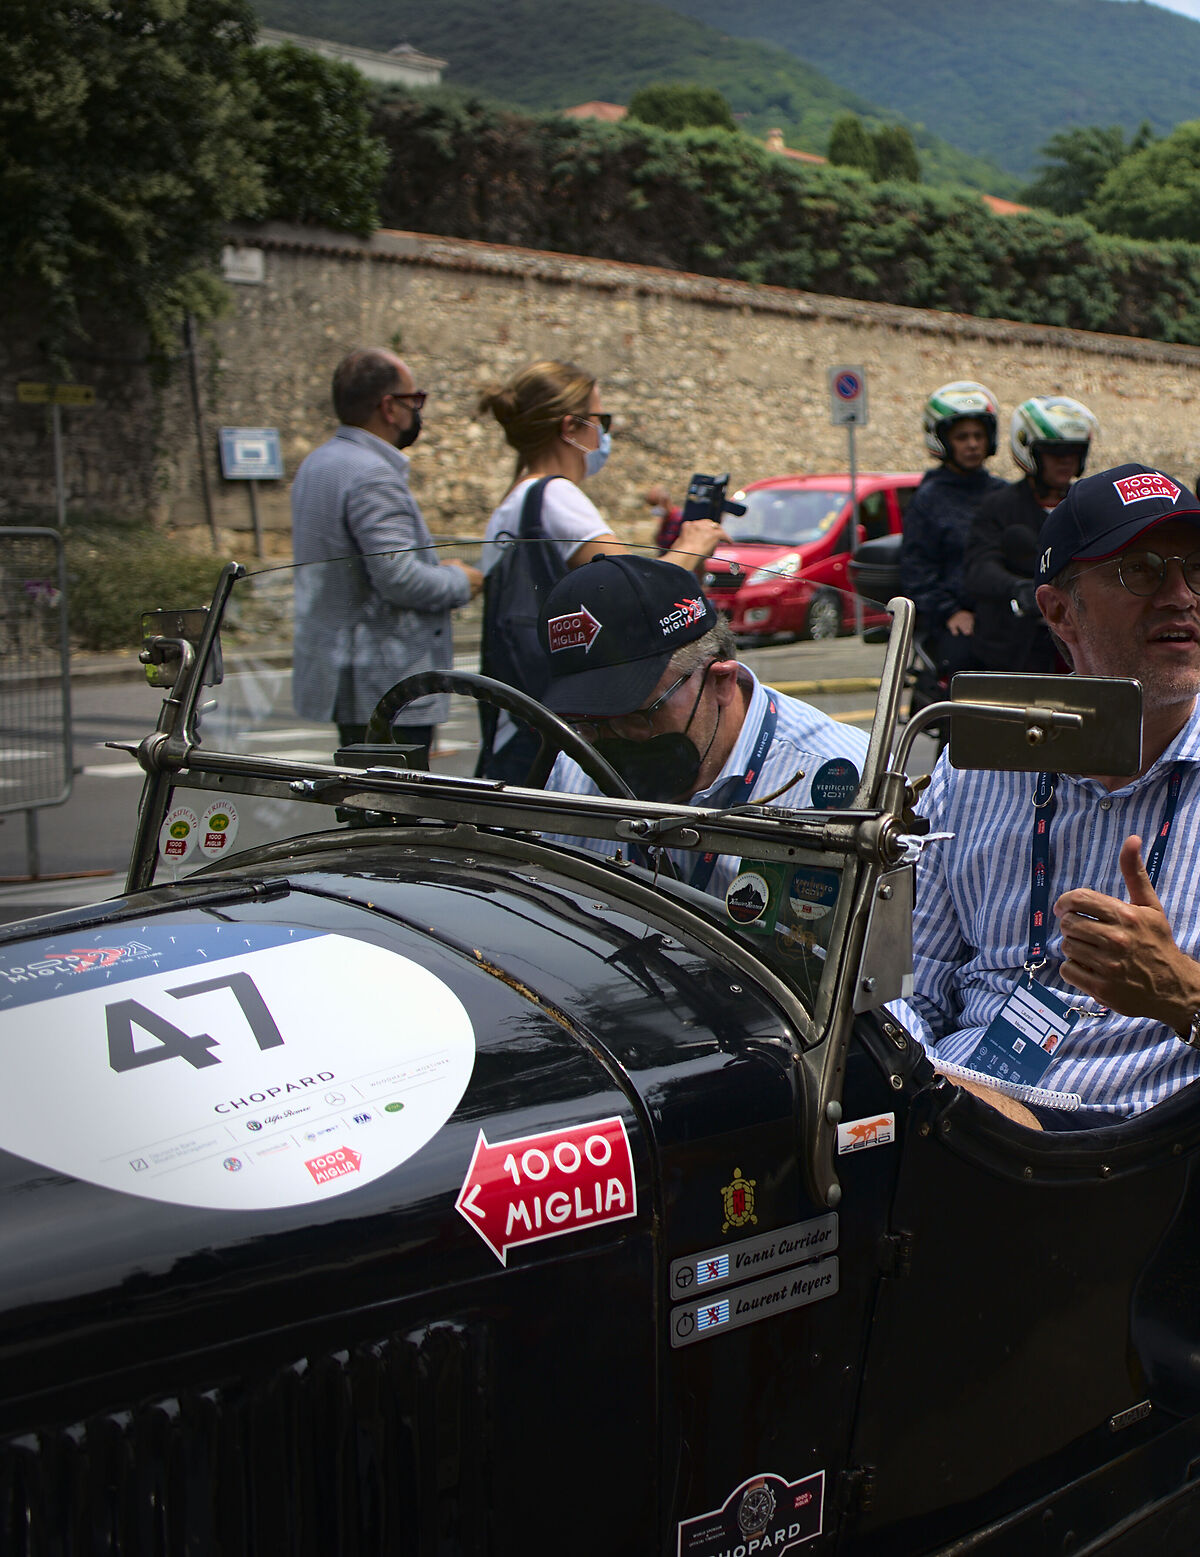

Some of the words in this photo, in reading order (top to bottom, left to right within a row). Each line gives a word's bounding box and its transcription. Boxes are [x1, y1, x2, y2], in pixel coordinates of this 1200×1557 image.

[1123, 477, 1163, 489] 1000
[1126, 486, 1171, 500] MIGLIA
[1040, 547, 1052, 573] 47
[551, 618, 582, 633] 1000
[659, 607, 689, 627] 1000
[662, 615, 694, 636] MIGLIA
[552, 631, 586, 647] MIGLIA
[8, 960, 95, 984] MIGLIA
[105, 972, 284, 1074] 47
[214, 1071, 335, 1114] CHOPARD
[353, 1113, 372, 1124] FIA
[840, 1135, 891, 1153] ZERO
[311, 1151, 346, 1170] 1000
[503, 1135, 612, 1186] 1000
[316, 1161, 356, 1184] MIGLIA
[505, 1177, 626, 1236] MIGLIA
[735, 1244, 775, 1269] Vanni
[778, 1229, 832, 1255] Curridor
[735, 1285, 788, 1315] Laurent
[790, 1273, 832, 1298] Meyers
[708, 1523, 800, 1557] HOPARD
